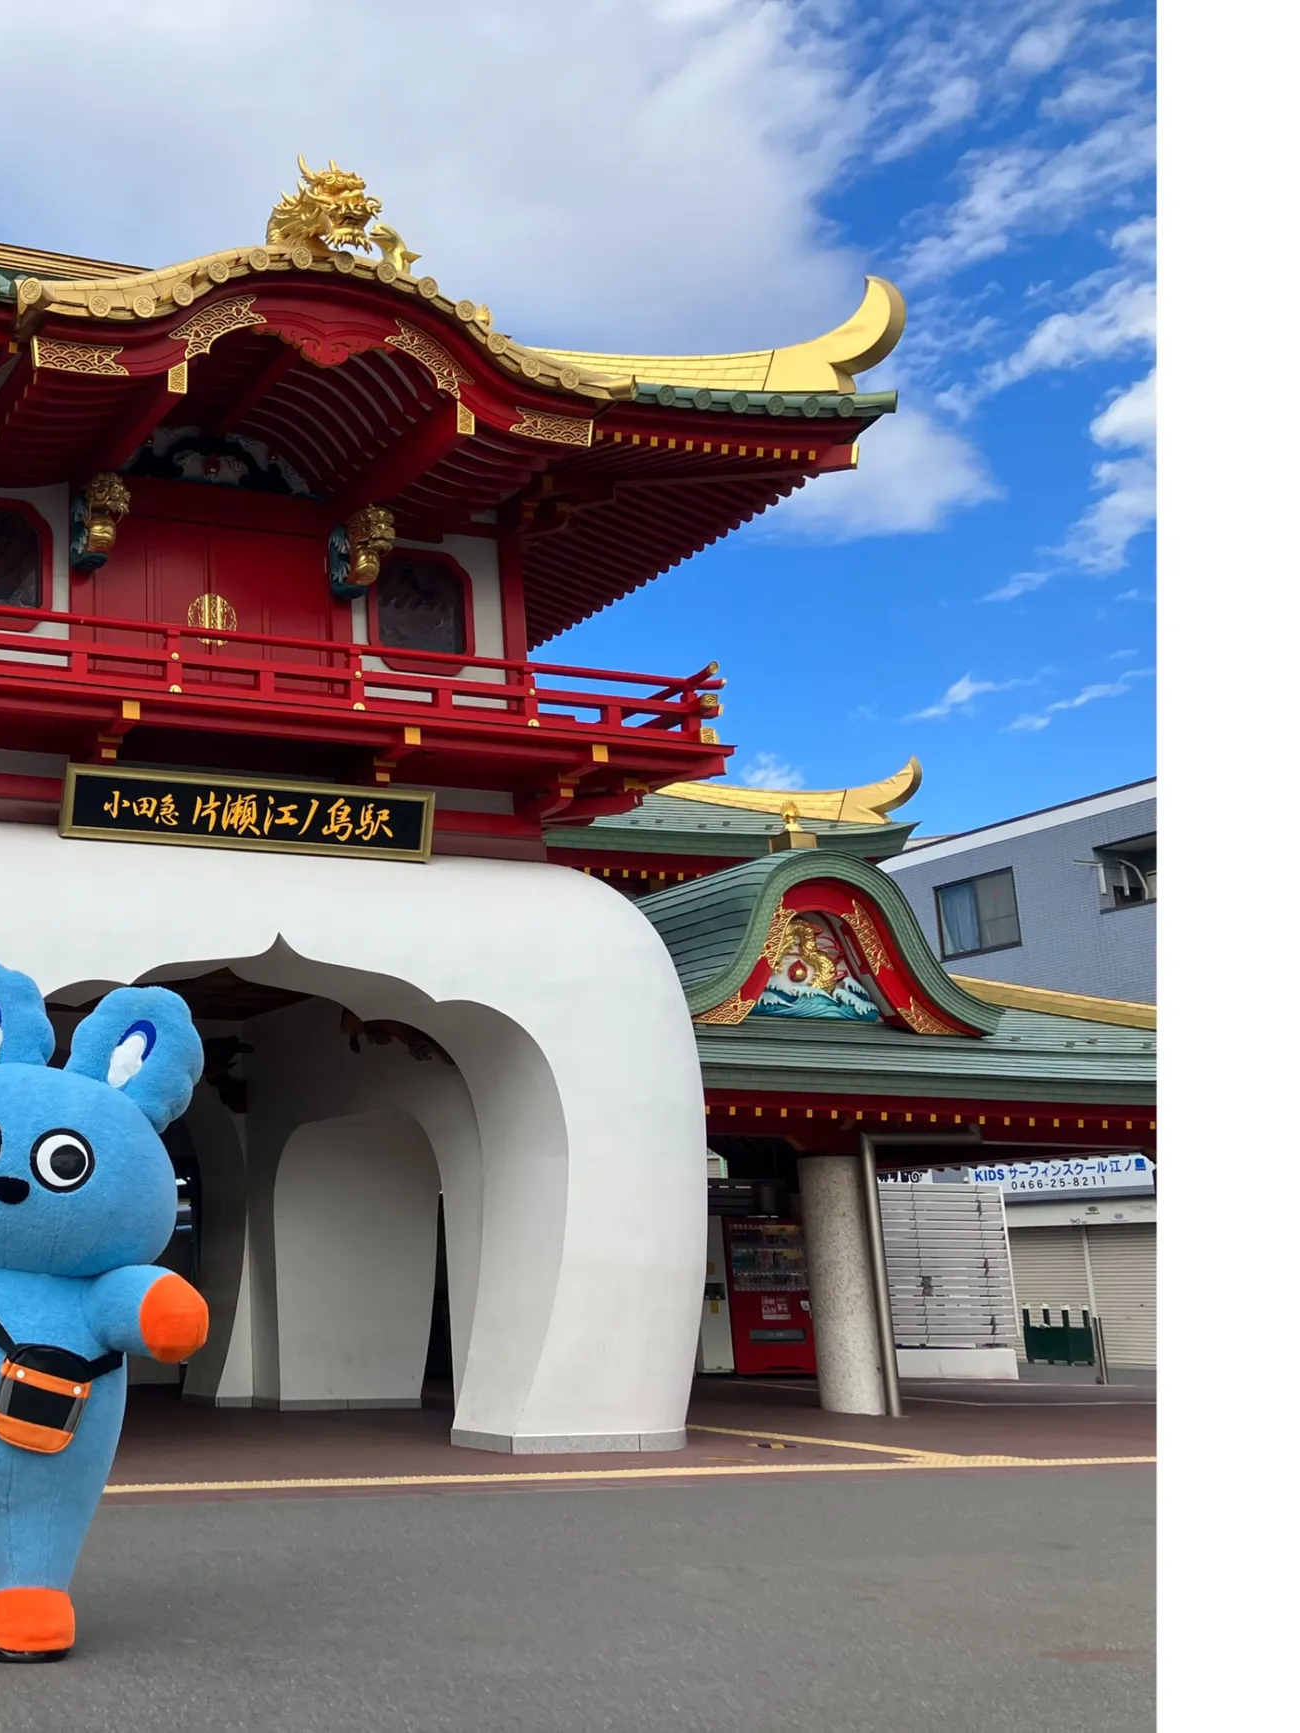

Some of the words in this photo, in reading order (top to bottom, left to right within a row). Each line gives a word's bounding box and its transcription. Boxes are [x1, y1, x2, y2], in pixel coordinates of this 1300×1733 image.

[103, 790, 180, 826] 小田急
[974, 1168, 1005, 1182] KIDS
[1011, 1175, 1107, 1191] 0466-25-8211
